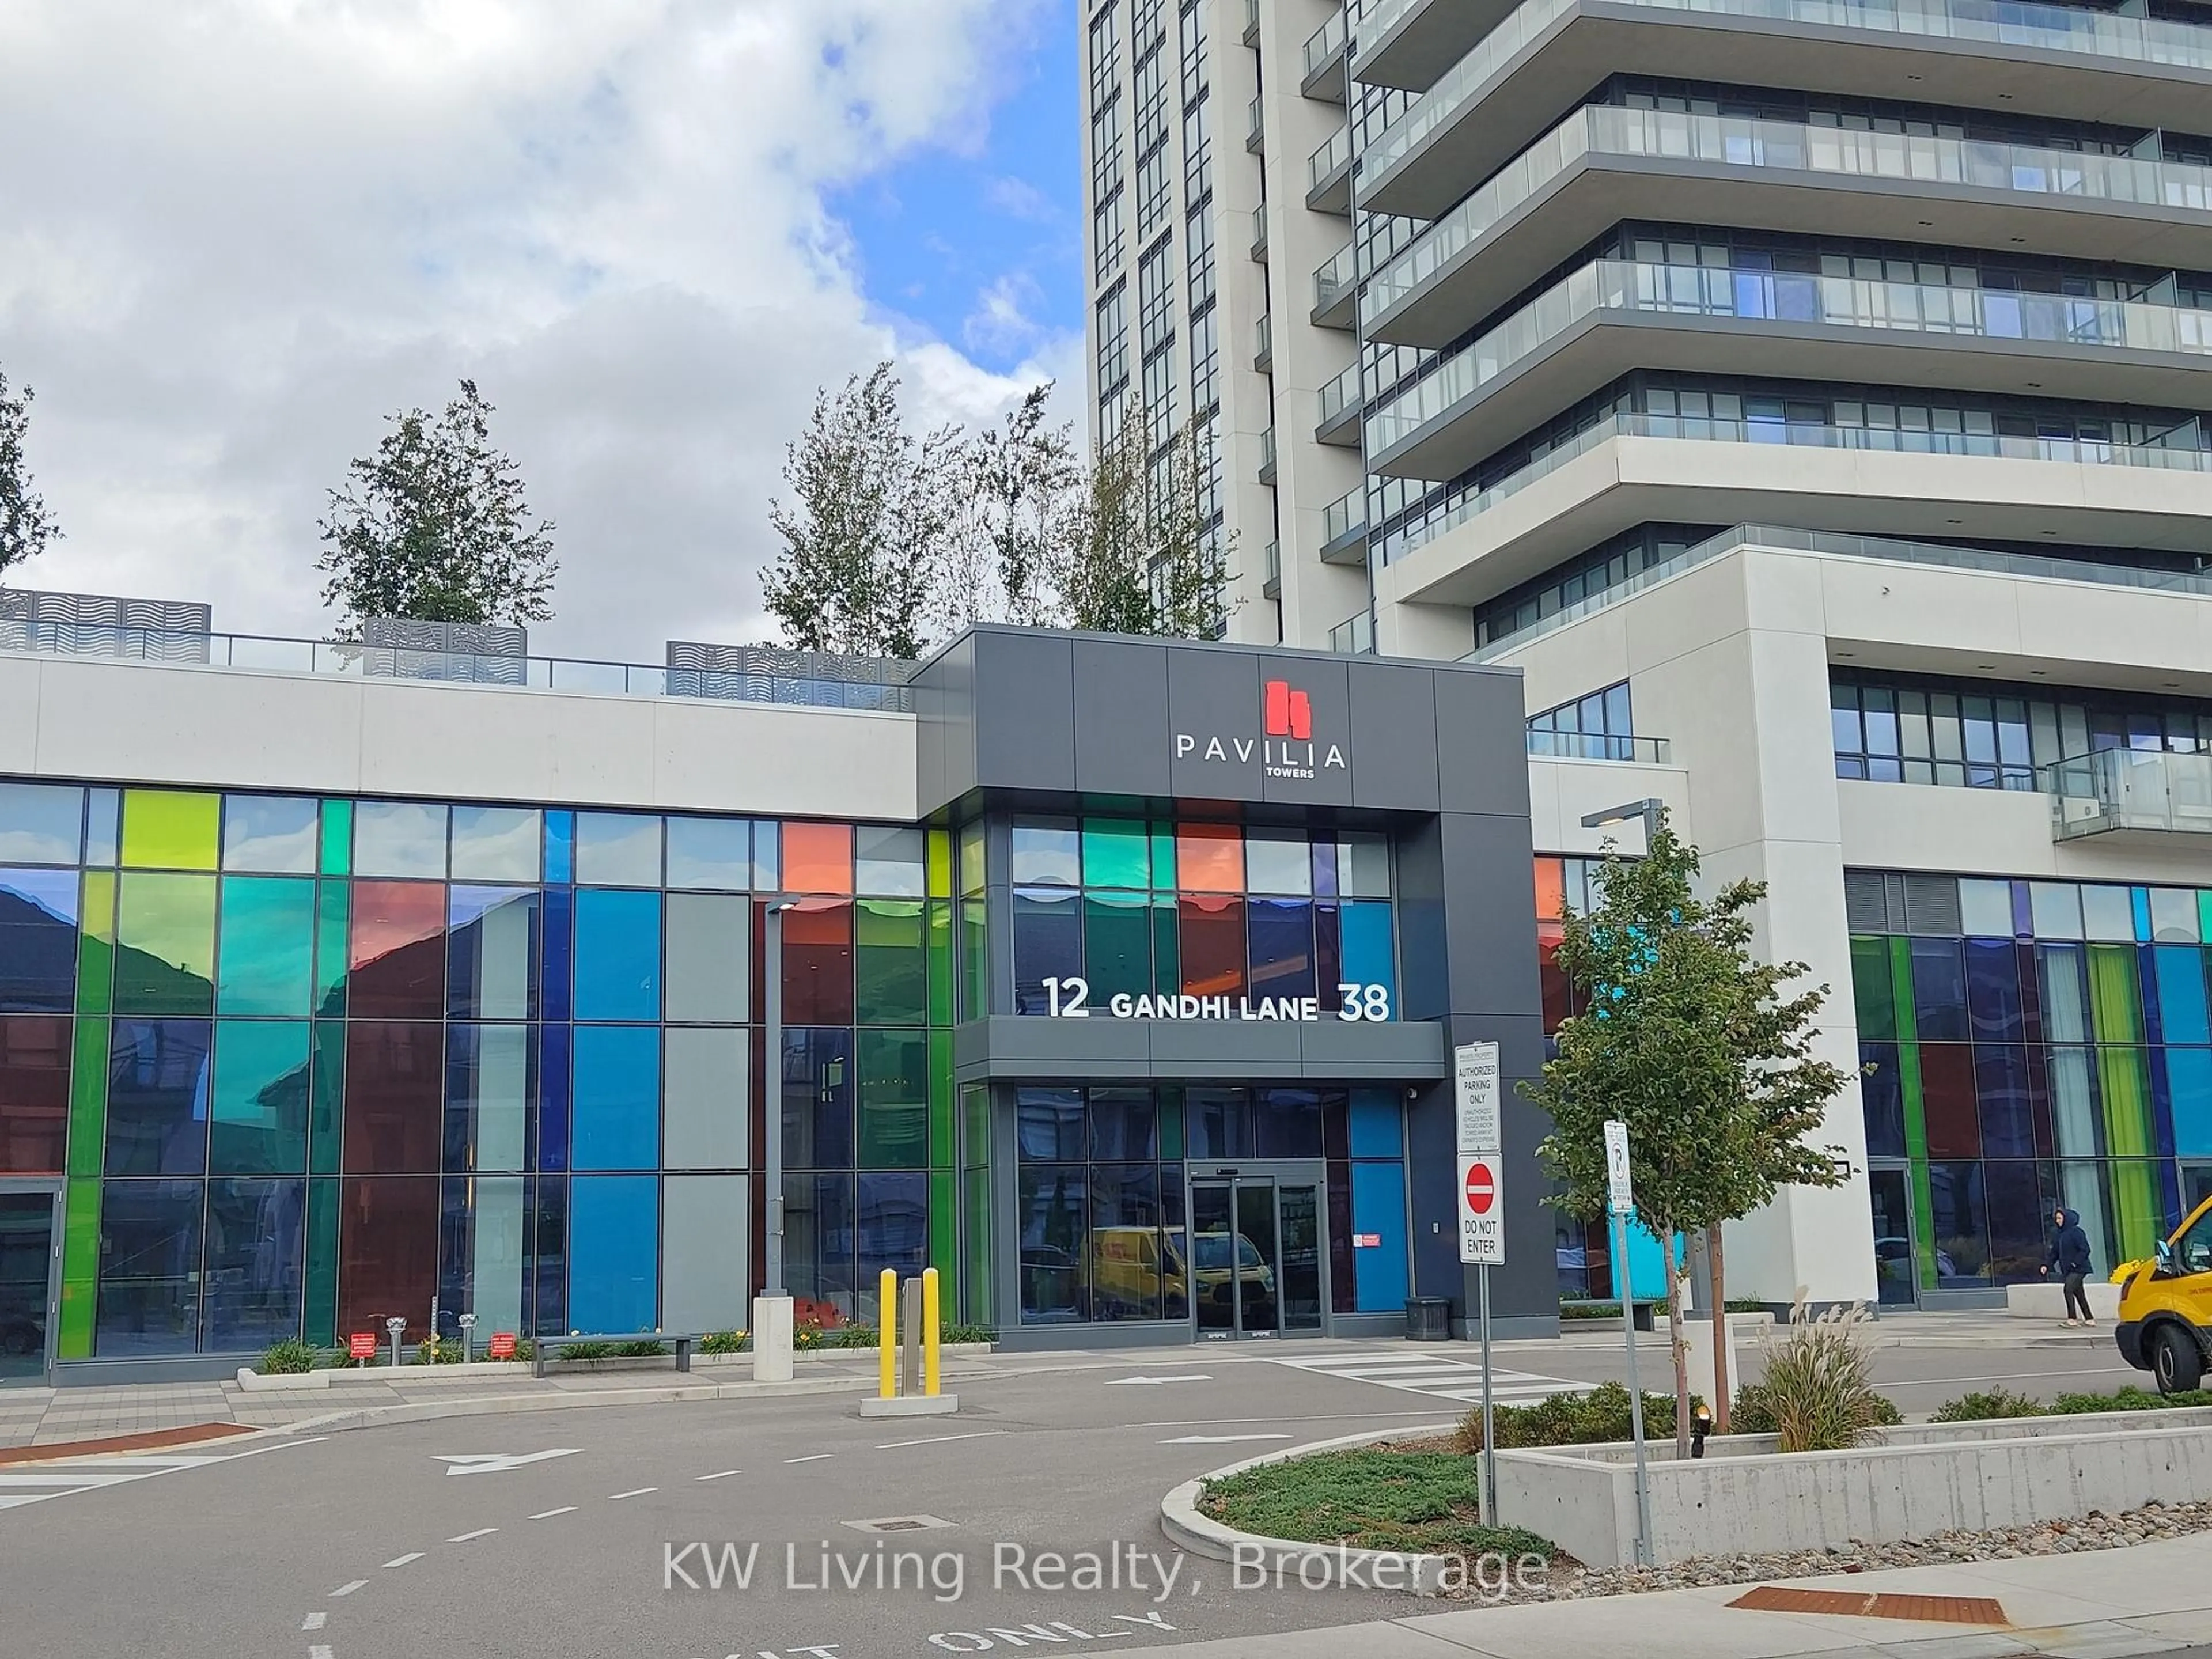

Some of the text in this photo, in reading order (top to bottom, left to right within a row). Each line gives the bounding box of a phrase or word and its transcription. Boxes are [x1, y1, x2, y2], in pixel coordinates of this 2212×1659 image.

[1177, 734, 1346, 768] PAVILIA
[1266, 767, 1315, 778] TOWERS
[1042, 977, 1390, 1022] 12 GANDHI LANE 38
[1459, 1065, 1496, 1078] AUTHORIZED
[1464, 1080, 1491, 1091] PARKING
[1469, 1094, 1486, 1104] ONLY
[1465, 1220, 1497, 1235] DO NOT
[1468, 1240, 1495, 1254] ENTER
[928, 1612, 1177, 1652] ONLY
